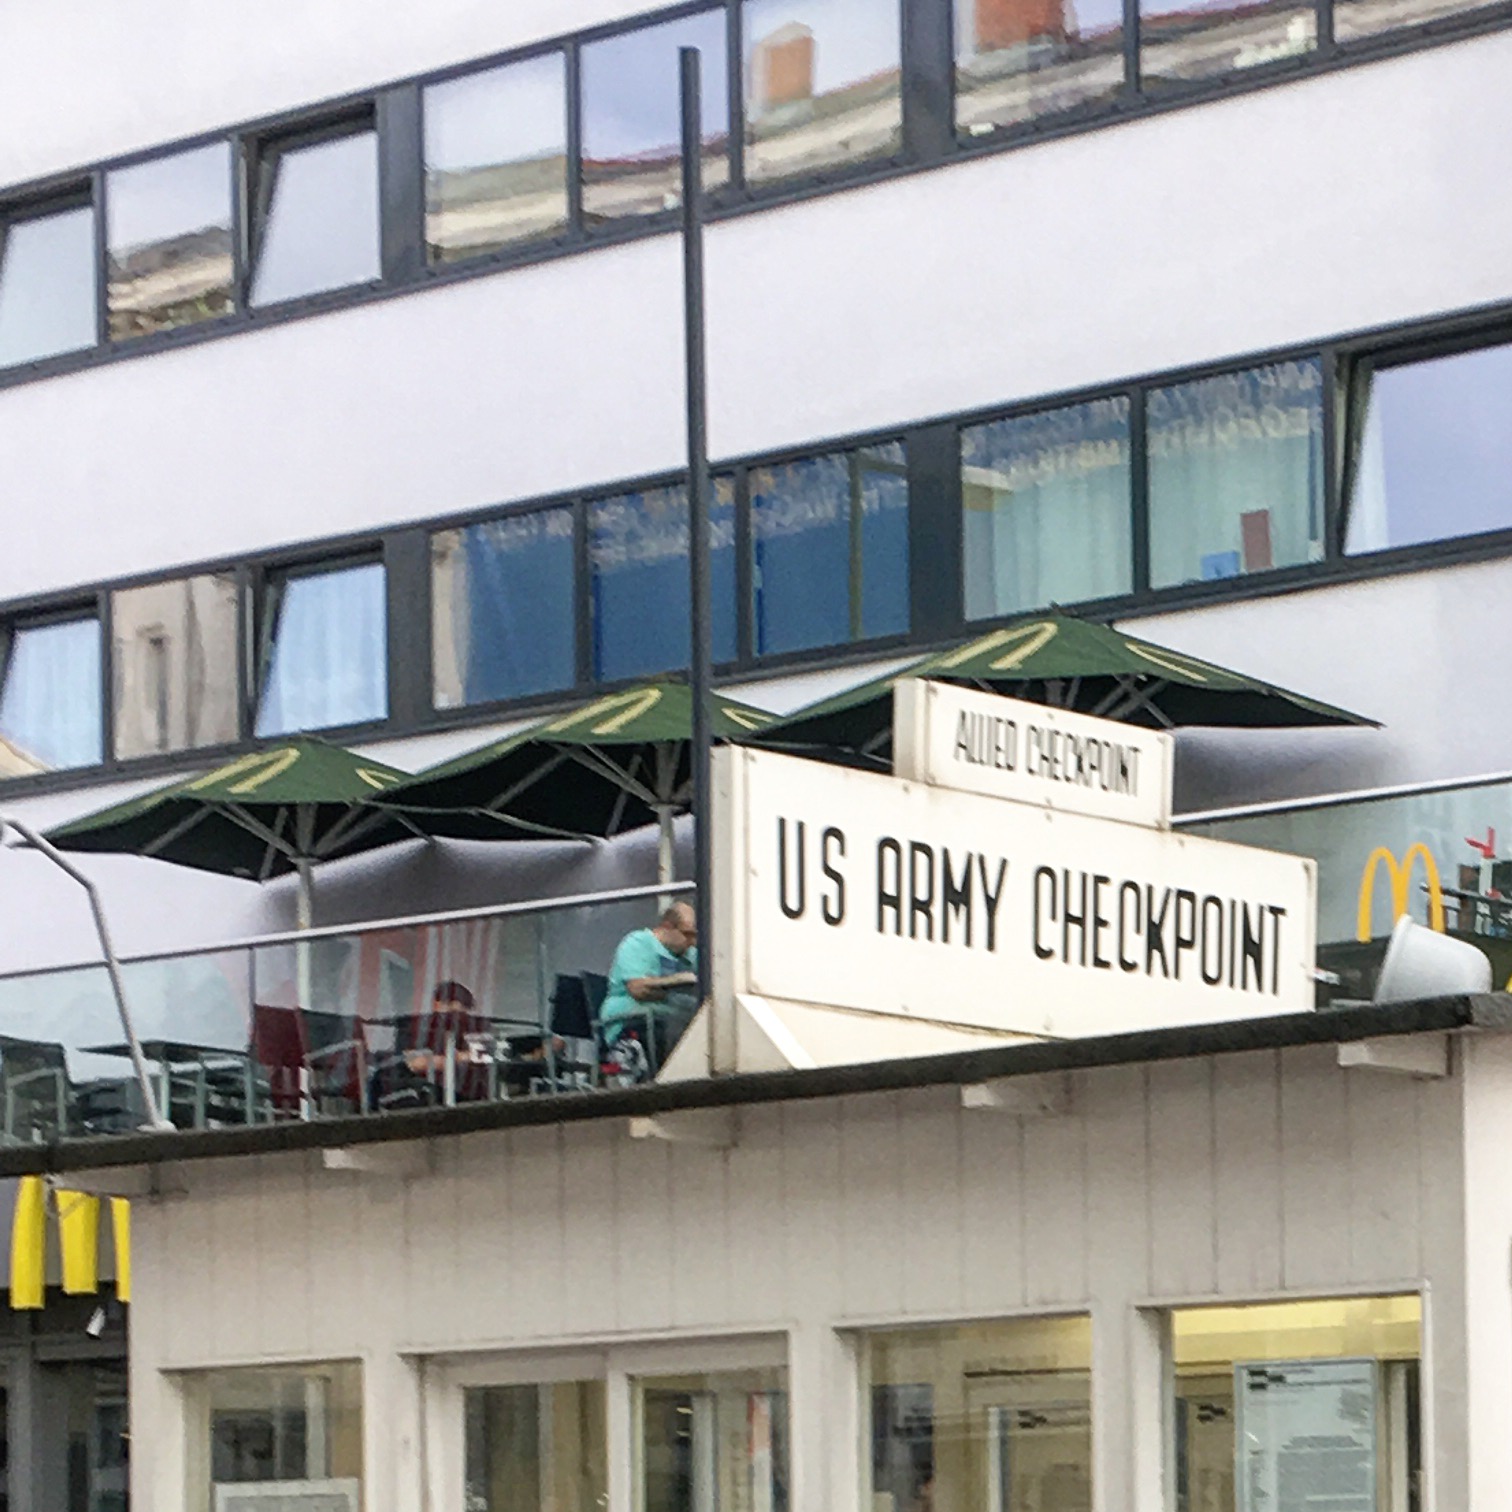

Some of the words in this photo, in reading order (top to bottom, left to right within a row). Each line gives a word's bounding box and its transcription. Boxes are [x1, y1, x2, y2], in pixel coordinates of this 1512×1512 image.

[954, 709, 1017, 772] ALLIED
[1026, 724, 1141, 797] CHECKPOINT
[876, 836, 1008, 952] ARMY
[1032, 864, 1287, 997] CHECKPOINT
